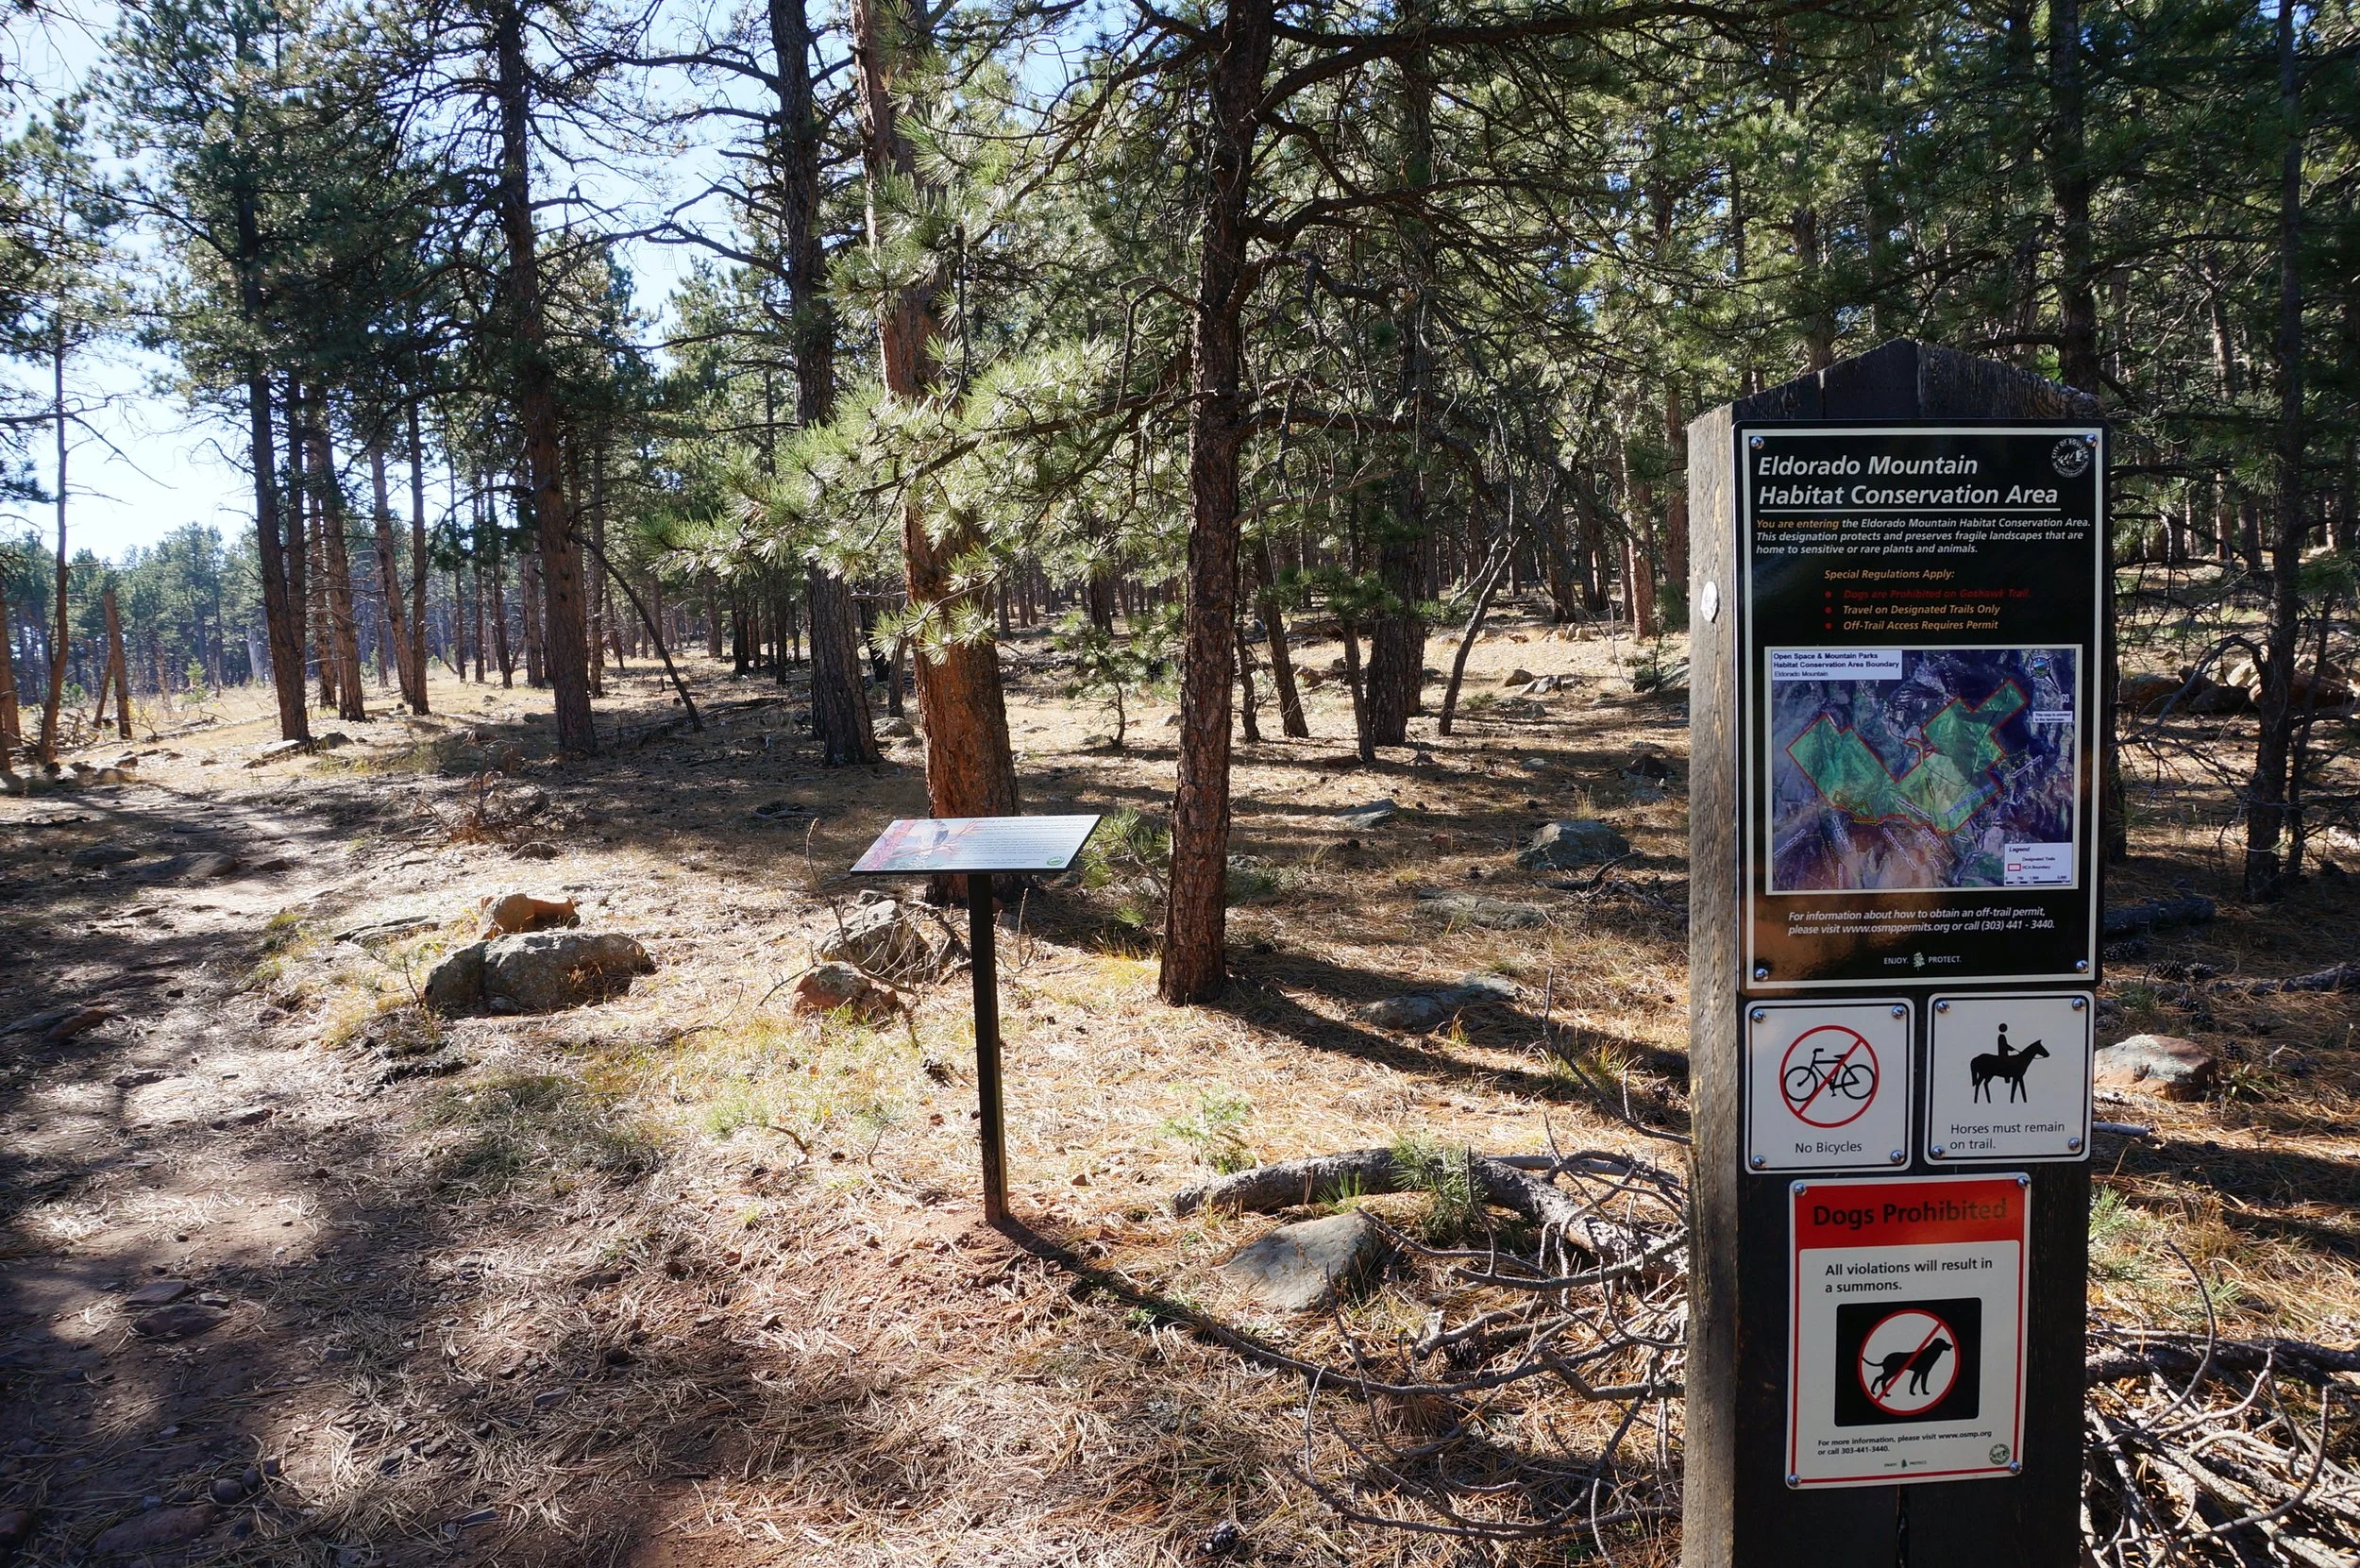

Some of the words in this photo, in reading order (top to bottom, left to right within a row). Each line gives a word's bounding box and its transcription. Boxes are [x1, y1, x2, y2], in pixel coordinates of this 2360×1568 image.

[1758, 455, 1861, 476] Eldorado
[1868, 454, 1979, 475] Mountain
[1759, 485, 1844, 505] Habitat
[1851, 484, 1999, 504] Conservation
[2005, 485, 2058, 503] Area
[1757, 520, 1775, 529] You
[1796, 519, 1840, 531] entering
[1842, 519, 1859, 528] the
[1861, 518, 1906, 529] Eldorado
[1908, 517, 1957, 528] Mountain
[1959, 517, 1997, 528] Habitat
[1998, 518, 2063, 528] Conservation
[2065, 517, 2091, 527] Area.
[1756, 531, 1777, 542] This
[1778, 531, 1838, 544] designation
[1840, 531, 1881, 544] protects
[1883, 531, 1902, 541] and
[1904, 531, 1952, 542] preserves
[1954, 531, 1987, 543] fragile
[1989, 531, 2042, 542] landscapes
[2045, 531, 2065, 540] that
[2067, 531, 2083, 540] are
[1756, 545, 1785, 554] home
[1800, 545, 1845, 554] sensitive
[1846, 546, 1859, 554] or
[1860, 546, 1880, 554] rare
[1882, 544, 1914, 555] plants
[1916, 544, 1935, 553] and
[1937, 544, 1978, 553] animals.
[1824, 569, 1859, 580] Special
[1862, 569, 1920, 581] Regulations
[1922, 569, 1955, 581] Apply:
[1843, 589, 1869, 600] Dogs
[1871, 590, 1887, 599] are
[1890, 589, 1941, 599] Prohibited
[1844, 605, 1873, 615] Travel
[1875, 606, 1888, 615] on
[1890, 605, 1947, 615] Designated
[1948, 604, 1974, 615] Trails
[1977, 604, 2000, 615] Only
[1843, 620, 1885, 631] Off-Trail
[1887, 620, 1919, 631] Access
[1921, 620, 1964, 632] Requires
[1966, 619, 1998, 630] Permit
[1773, 652, 1792, 661] Open
[1794, 652, 1814, 661] Space
[1865, 661, 1900, 669] Boundary
[1789, 911, 1804, 921] For
[1806, 910, 1862, 920] information
[1863, 910, 1892, 919] about
[1894, 909, 1915, 919] how
[1917, 910, 1928, 919] to
[1930, 908, 1960, 919] obtain
[1976, 907, 2012, 918] off-trail
[2013, 906, 2045, 919] permit,
[1788, 924, 1819, 936] please
[1821, 924, 1840, 934] visit
[1842, 923, 1949, 934] www.osmppermits.org
[1964, 920, 1980, 930] call
[1981, 920, 2004, 932] (303)
[2006, 920, 2022, 930] 441
[2031, 919, 2054, 929] 3440.
[1950, 1123, 1989, 1135] Horses
[1993, 1122, 2021, 1134] must
[2024, 1121, 2065, 1133] remain
[1795, 1143, 1812, 1153] No
[1816, 1140, 1863, 1155] Bicycles
[1949, 1141, 1965, 1150] on
[1969, 1138, 1997, 1150] trail.
[1813, 1205, 1875, 1231] Dogs
[1883, 1198, 2008, 1224] Prohibited
[1826, 1264, 1843, 1275] All
[1847, 1262, 1911, 1275] violations
[1914, 1259, 1938, 1273] will
[1942, 1258, 1978, 1271] result
[1981, 1257, 1993, 1269] in
[1836, 1281, 1902, 1292] summons.
[1851, 1436, 1896, 1444] information,
[1897, 1435, 1920, 1443] please
[1938, 1430, 1992, 1440] www.osmp.org
[1841, 1446, 1890, 1455] 303-441-3440.
